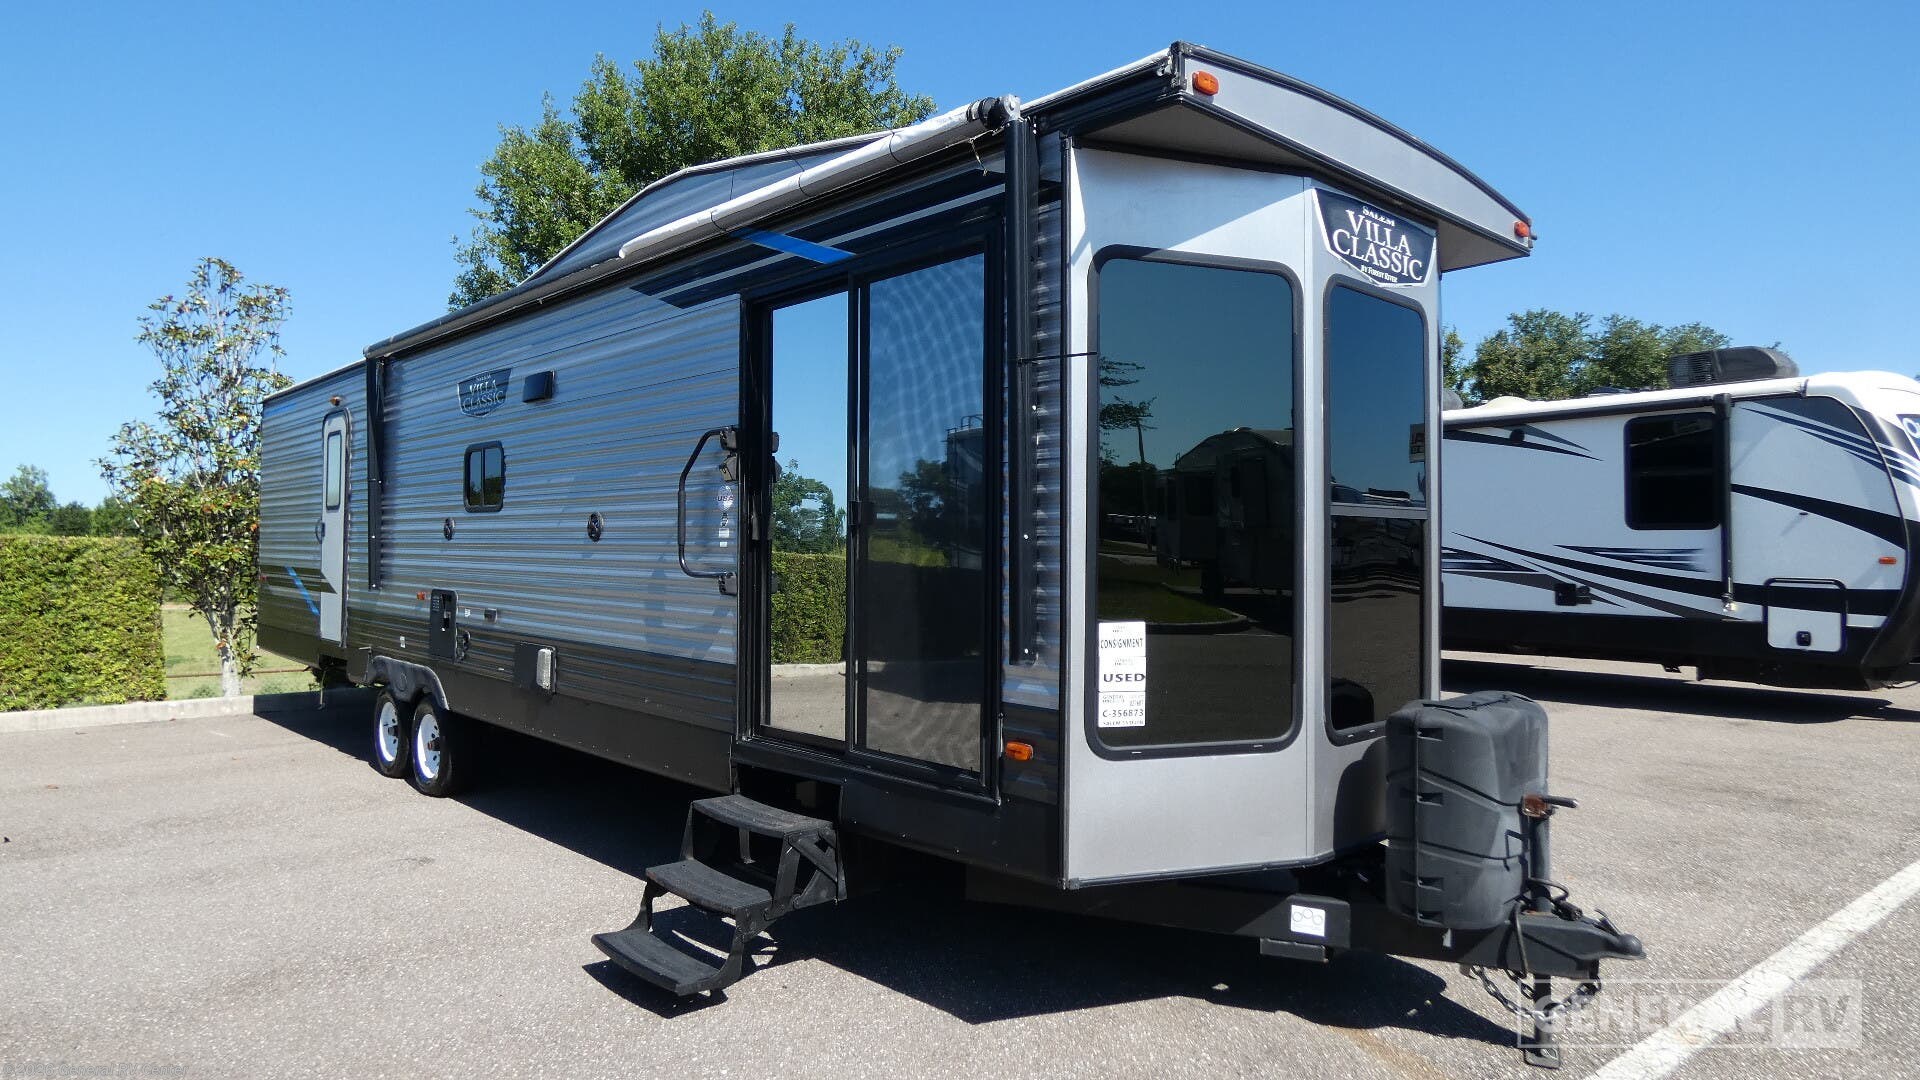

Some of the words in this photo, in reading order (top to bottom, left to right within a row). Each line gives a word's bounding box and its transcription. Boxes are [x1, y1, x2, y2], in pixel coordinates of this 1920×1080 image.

[1345, 209, 1412, 257] VILLA
[1333, 228, 1422, 280] CLASSIC
[463, 391, 504, 411] CLASSIC
[1100, 638, 1143, 648] CONSIGNMENT
[1103, 673, 1146, 682] USED
